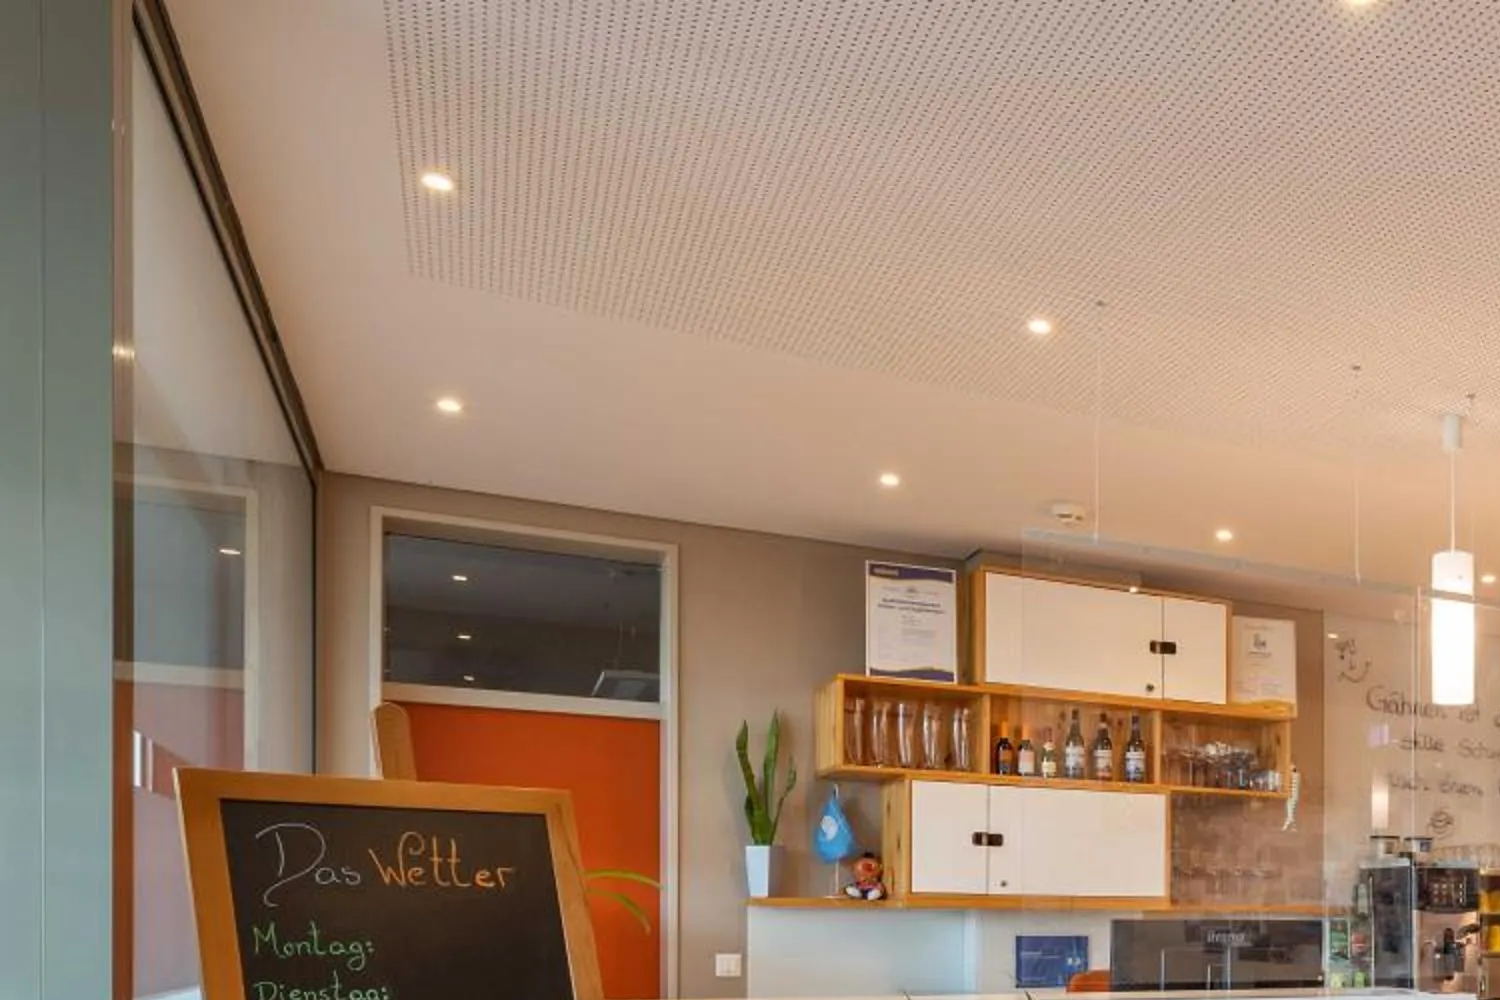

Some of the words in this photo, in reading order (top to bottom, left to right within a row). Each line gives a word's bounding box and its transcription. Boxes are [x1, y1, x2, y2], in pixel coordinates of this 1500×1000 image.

[255, 823, 361, 907] Das
[369, 831, 516, 888] Wetter
[253, 922, 375, 971] Montag:
